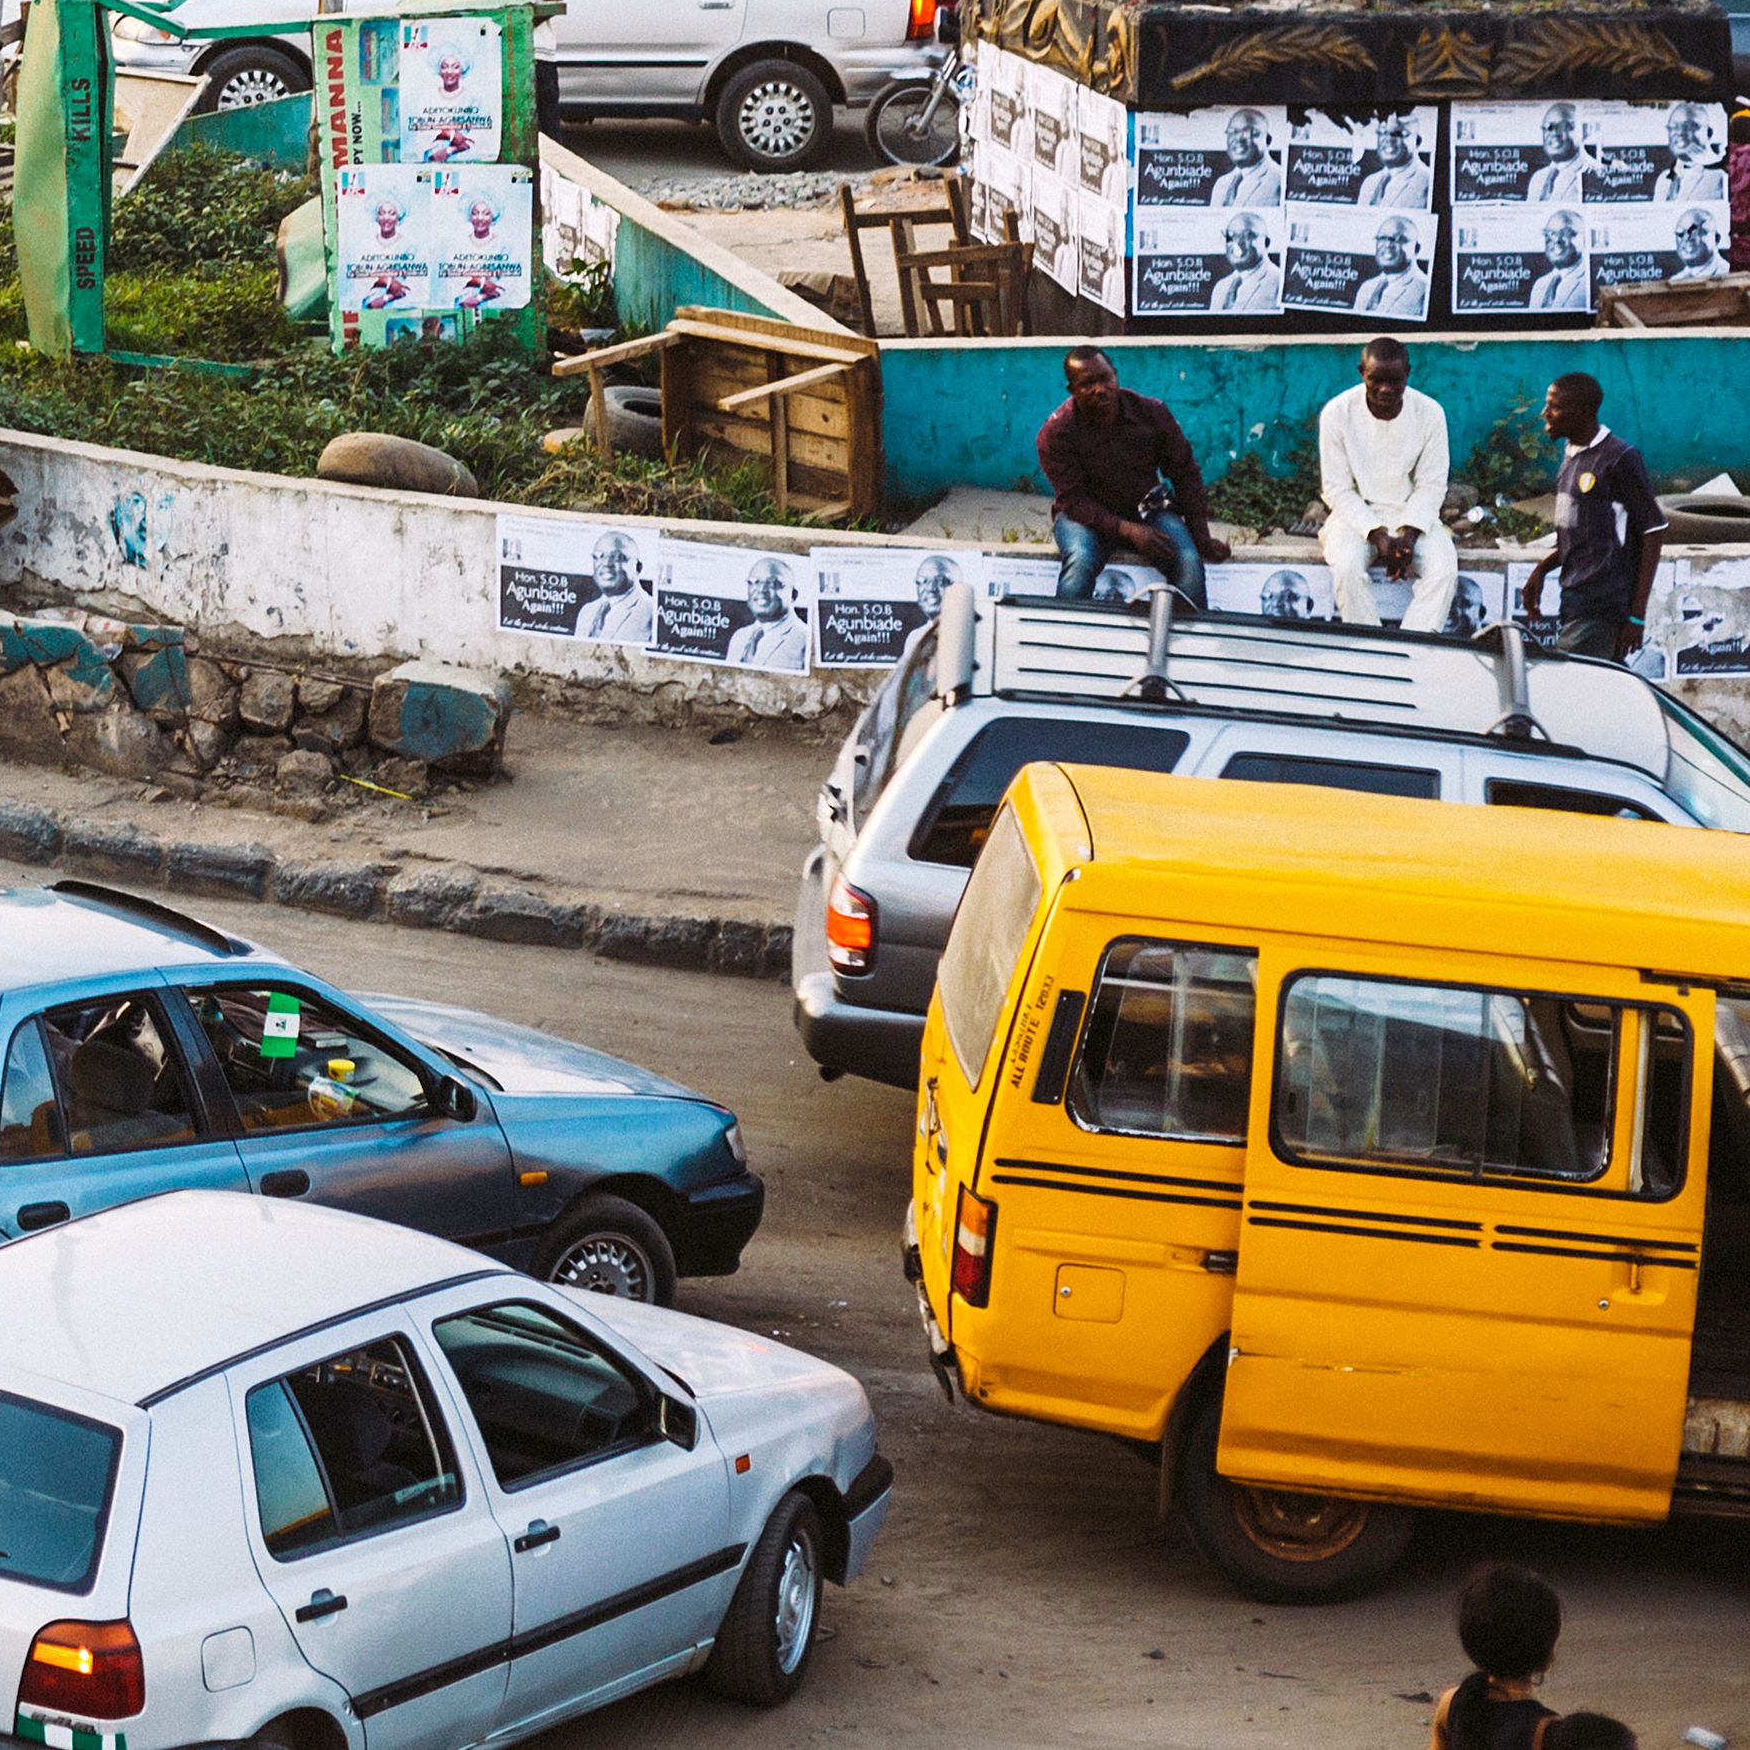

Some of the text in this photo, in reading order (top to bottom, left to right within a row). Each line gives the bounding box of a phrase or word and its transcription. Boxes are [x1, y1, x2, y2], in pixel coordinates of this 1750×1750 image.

[325, 28, 349, 170] MANNA
[1145, 162, 1213, 180] Agunbiade
[1293, 160, 1361, 179] Agunbiade
[1461, 159, 1528, 176] Agunbiade
[71, 78, 95, 289] SPEED KILLS
[1144, 268, 1212, 286] Agunbiade
[1291, 261, 1359, 281] Agunbiade
[1462, 267, 1530, 284] Agunbiade
[515, 571, 537, 583] Hon.
[506, 580, 576, 603] Agunbiade
[664, 595, 687, 608] Hon.
[835, 603, 859, 615] Hon.
[658, 605, 729, 628] Agunbiade
[826, 614, 902, 633] Agunbiade
[1011, 1066, 1025, 1089] ALL
[1019, 1019, 1040, 1063] ROUTE
